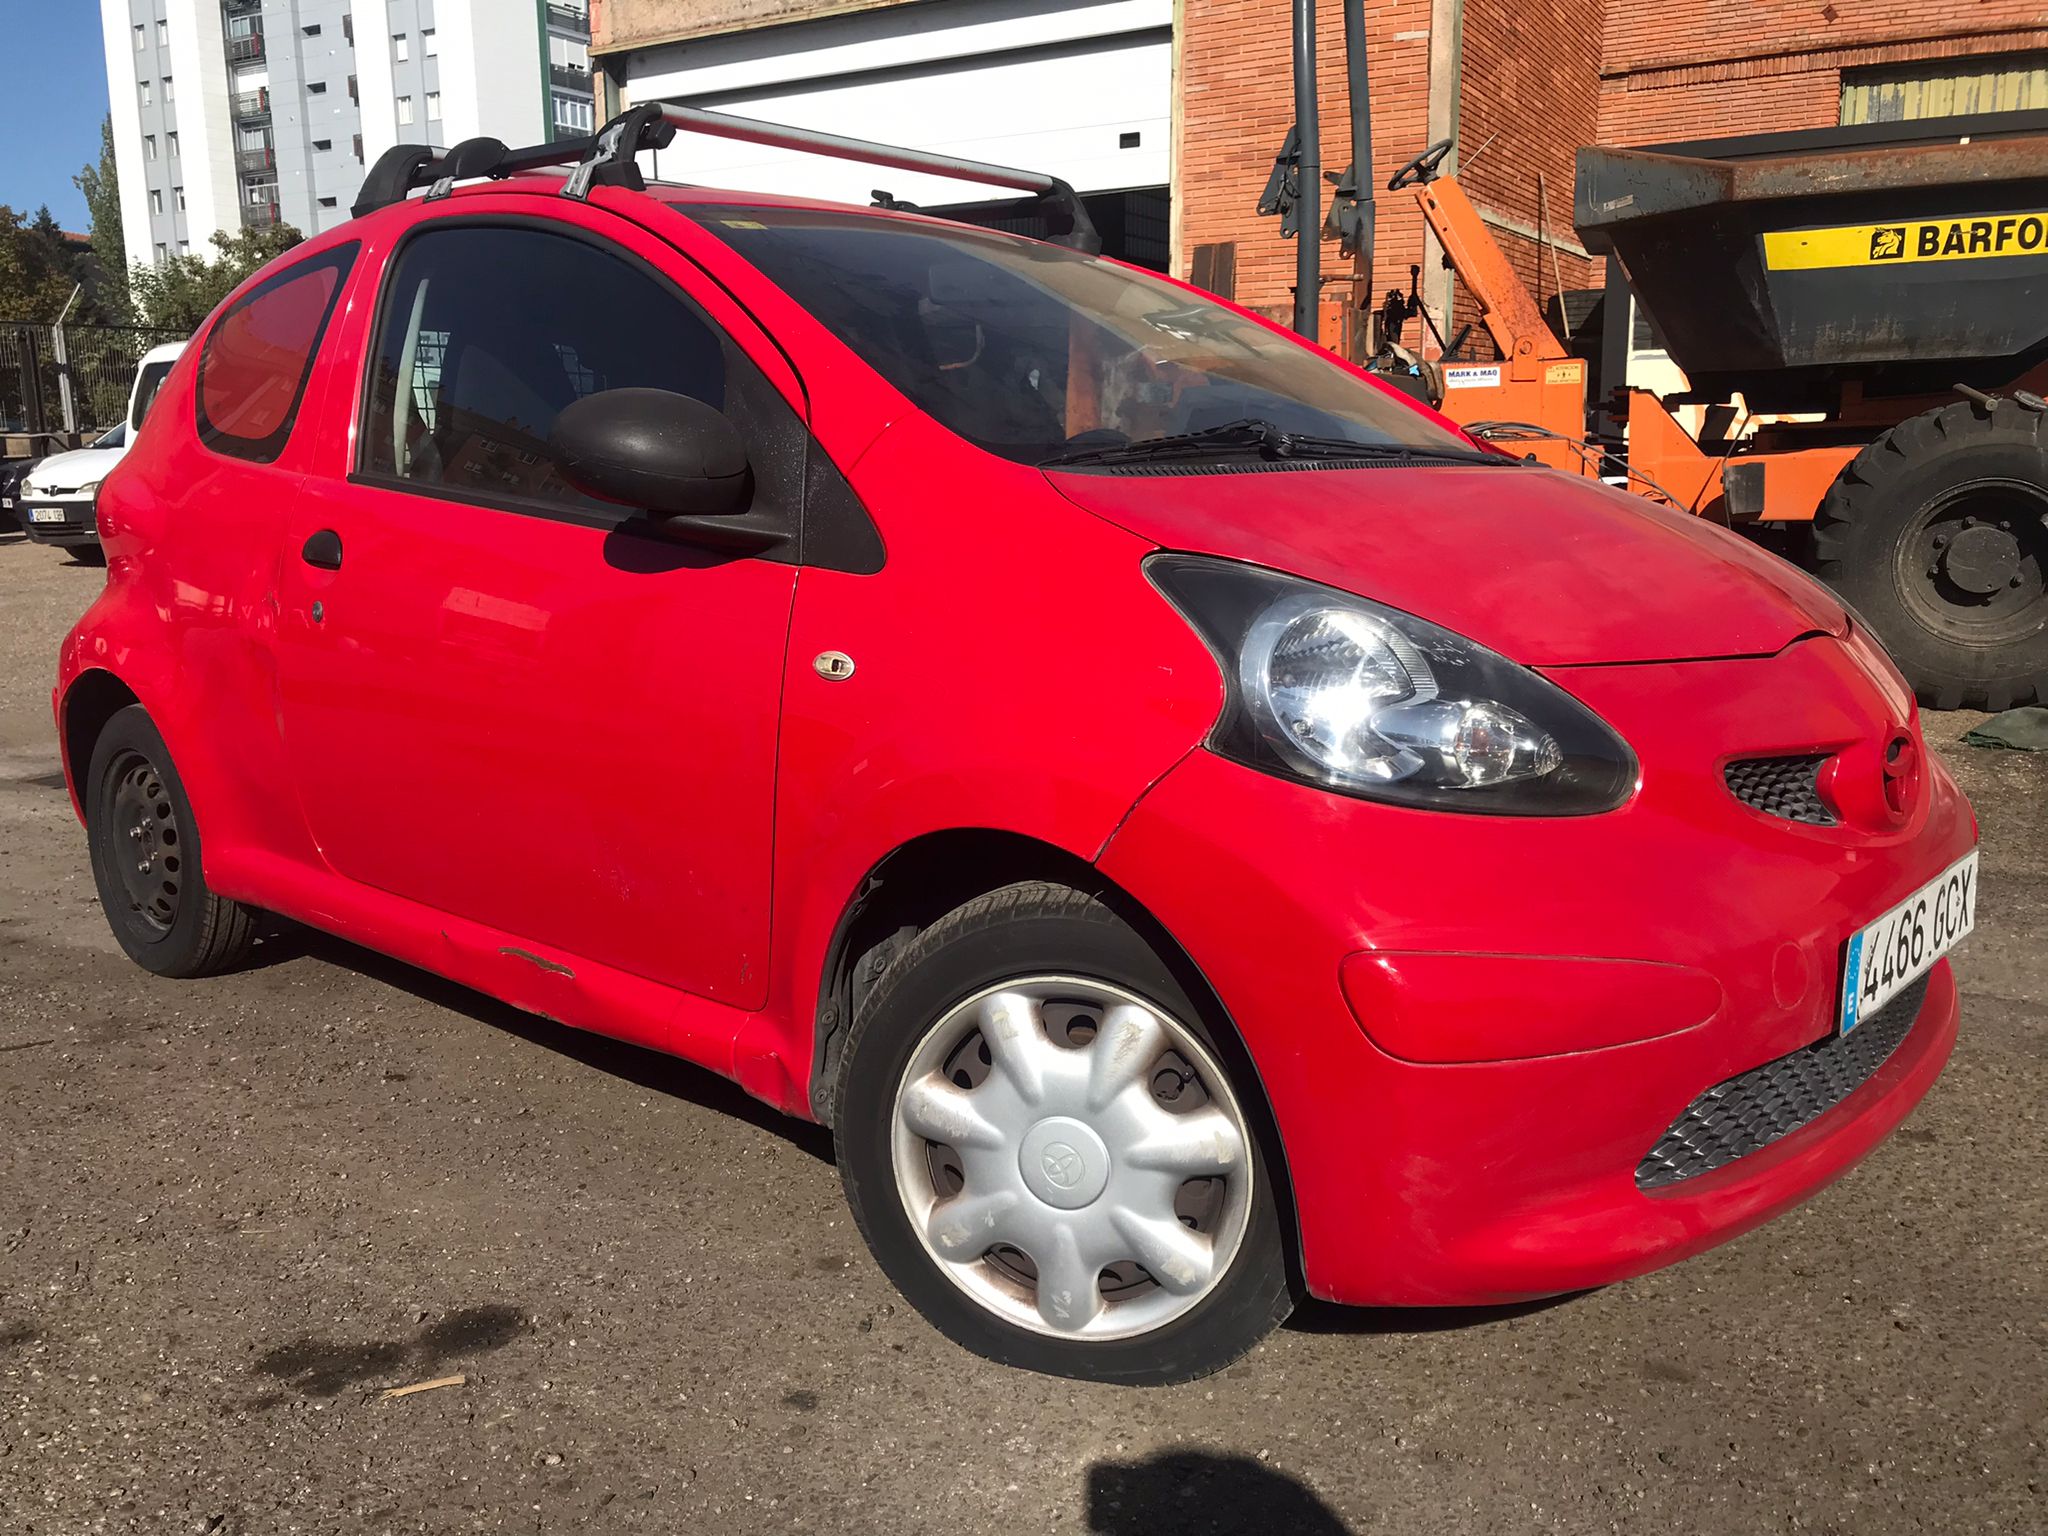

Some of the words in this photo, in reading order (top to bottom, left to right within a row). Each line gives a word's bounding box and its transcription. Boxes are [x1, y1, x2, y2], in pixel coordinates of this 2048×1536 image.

[1917, 216, 2048, 257] BARFO
[1863, 899, 1926, 1002] 4466
[1933, 863, 1973, 951] GCX
